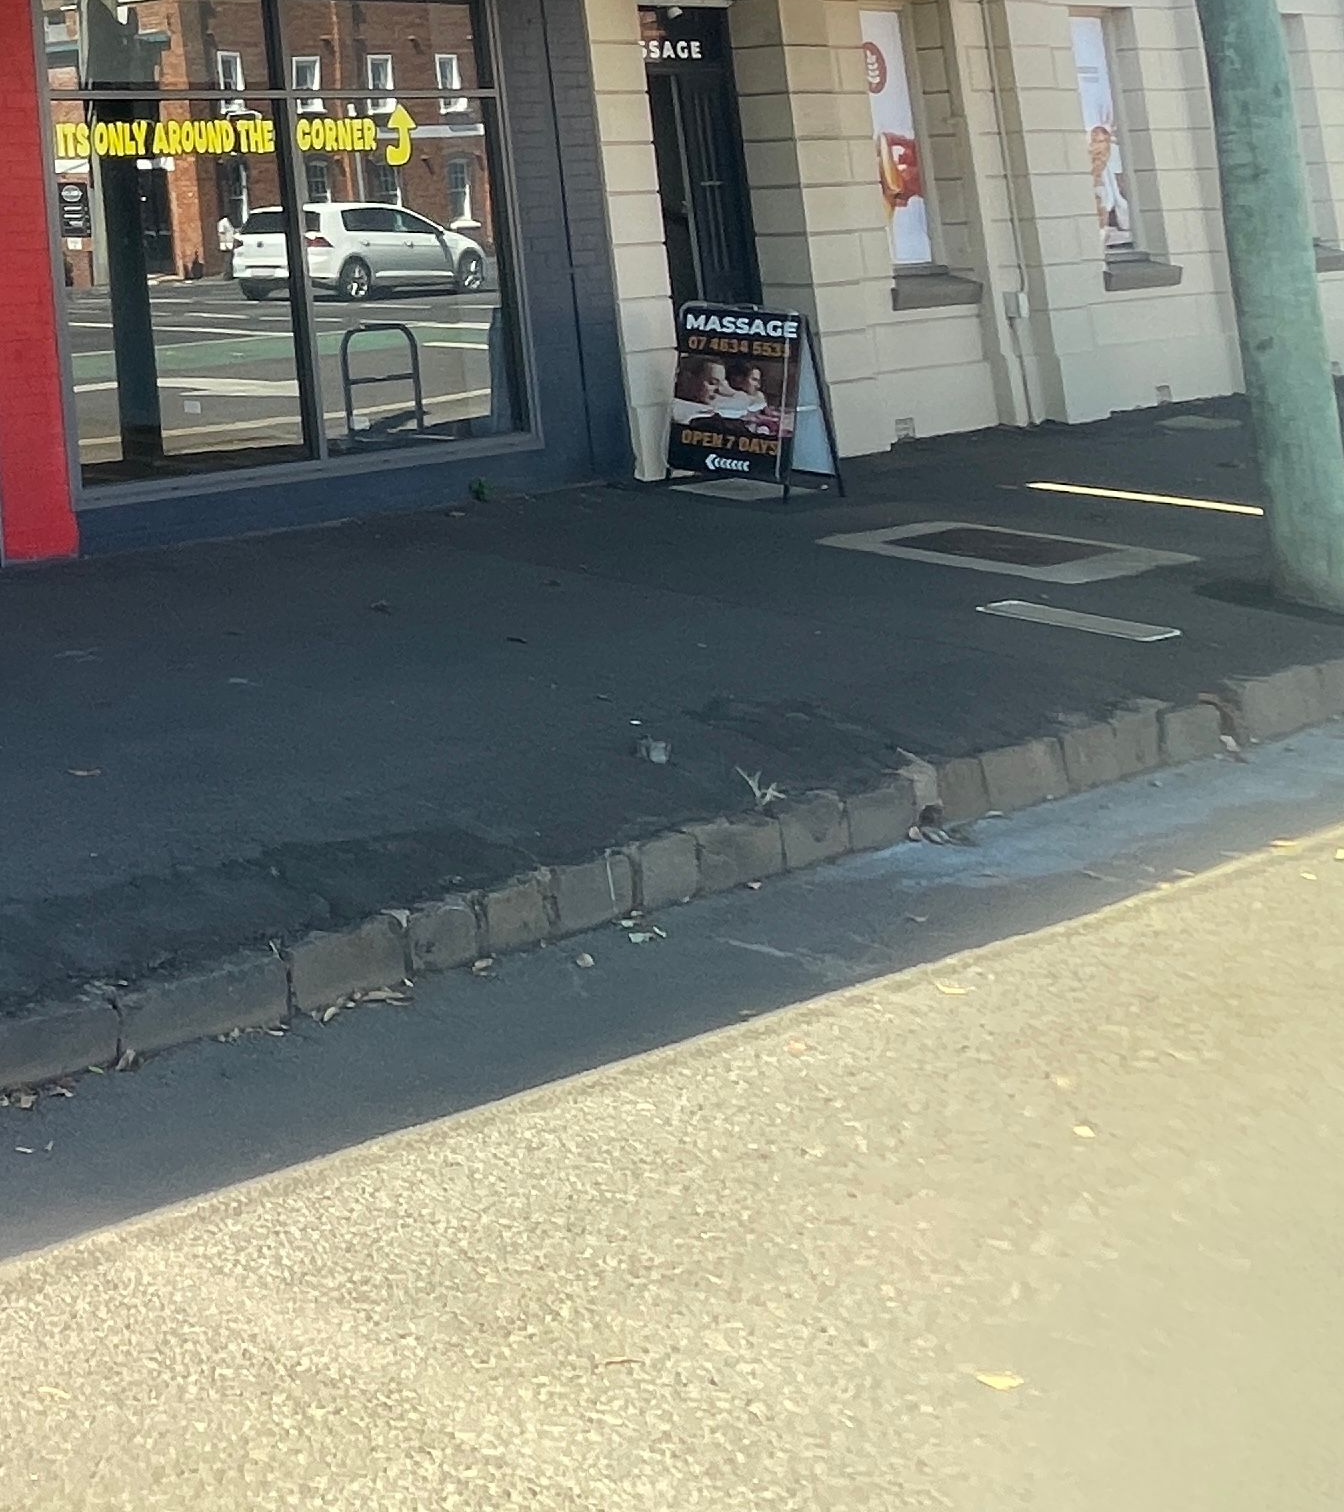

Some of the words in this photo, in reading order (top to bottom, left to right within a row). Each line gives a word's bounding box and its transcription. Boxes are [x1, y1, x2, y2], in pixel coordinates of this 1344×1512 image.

[55, 121, 90, 158] ITS
[94, 120, 147, 156] ONLY
[152, 119, 235, 155] AROUND
[236, 119, 276, 153] THE
[296, 118, 377, 152] CORNER
[686, 313, 799, 338] MASSAGE
[681, 429, 723, 449] OPEN
[725, 436, 736, 450] 7
[738, 436, 779, 456] DAYS
